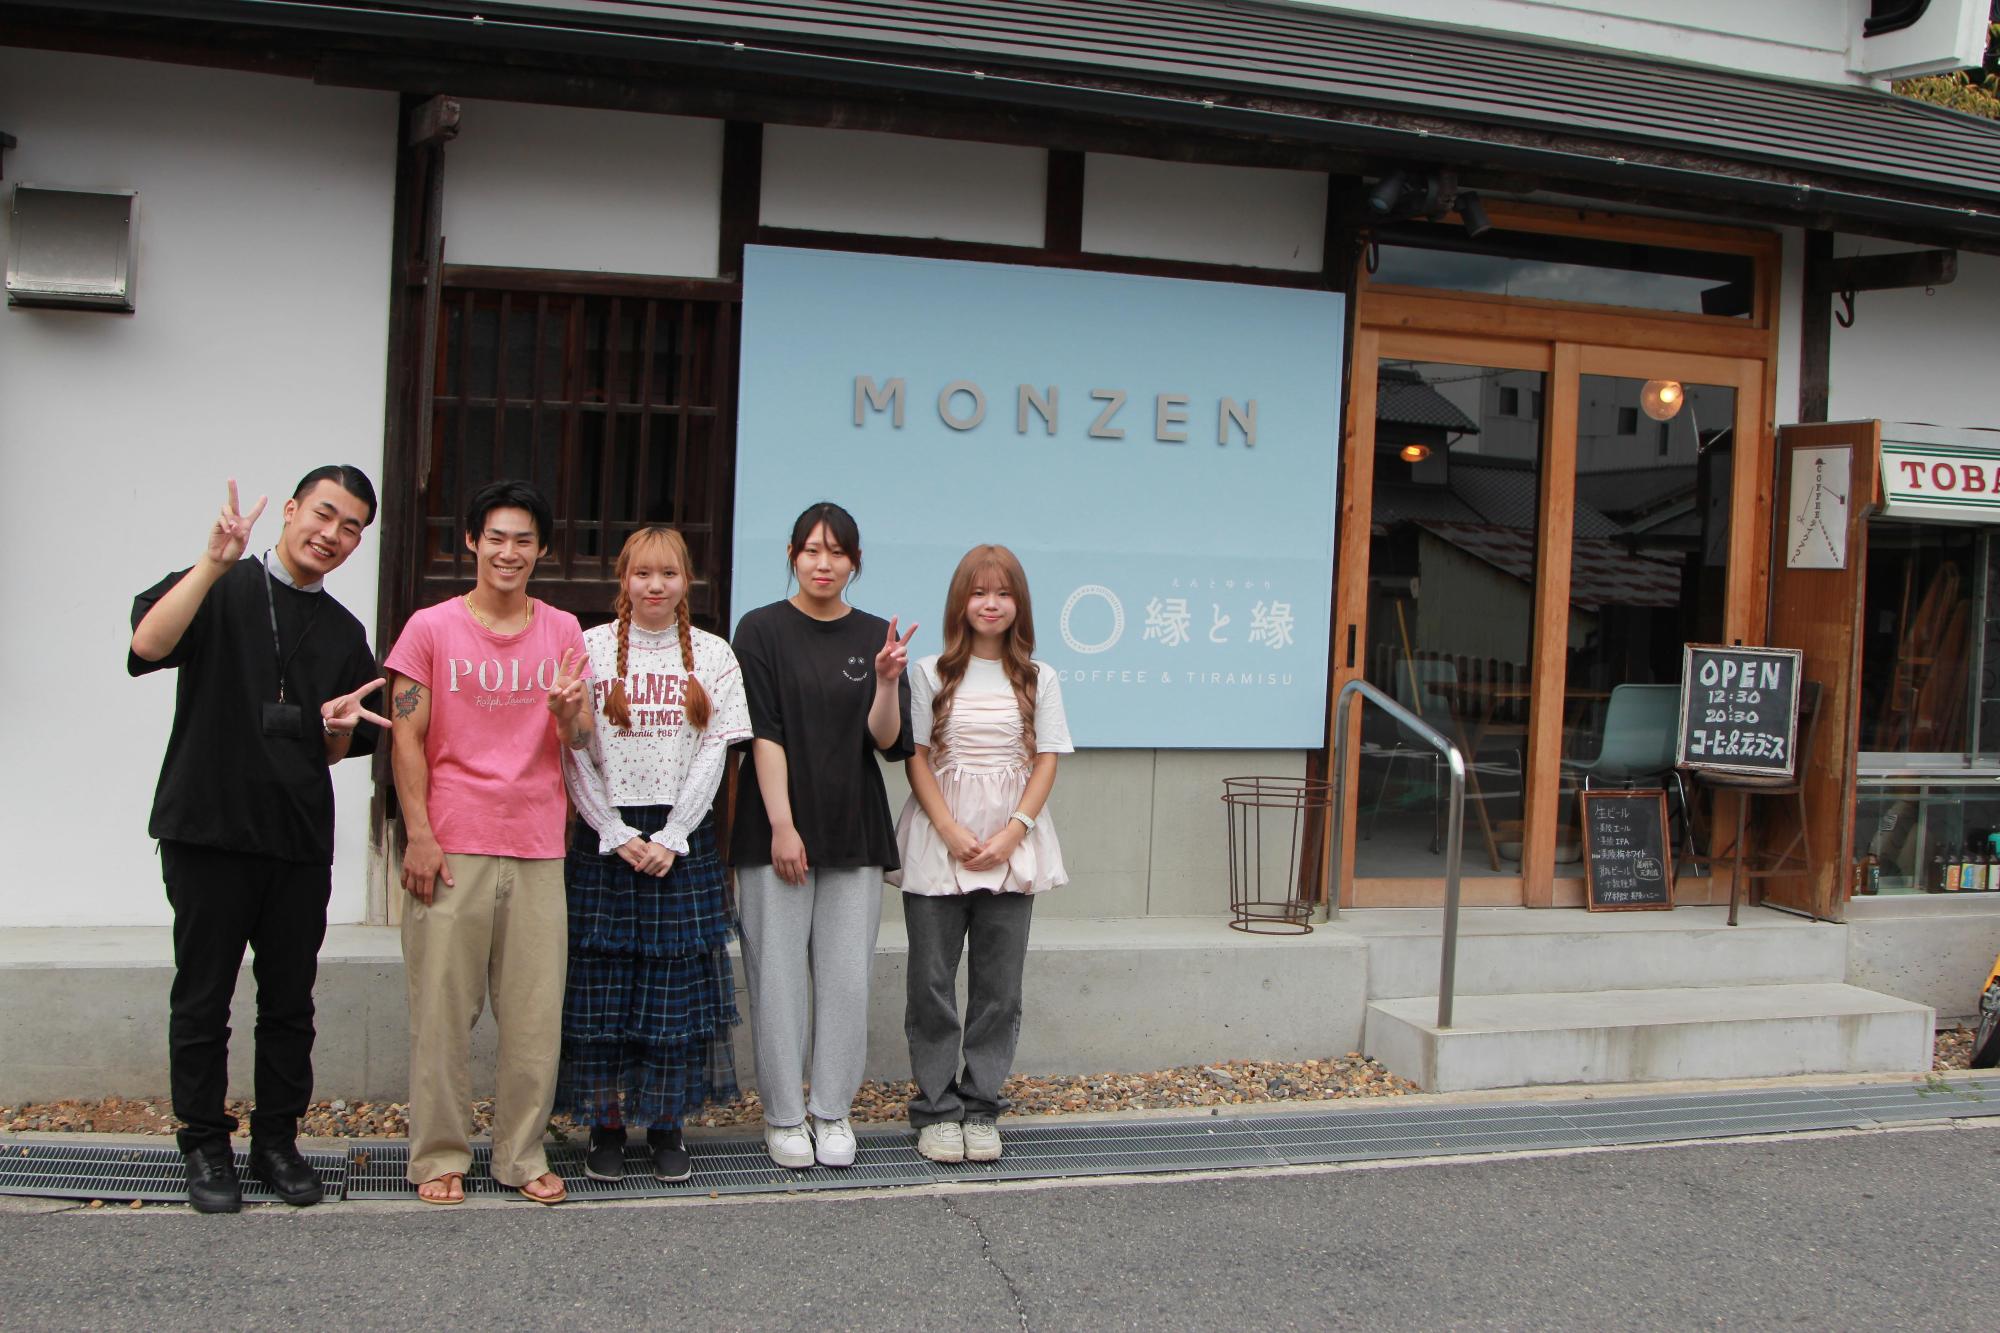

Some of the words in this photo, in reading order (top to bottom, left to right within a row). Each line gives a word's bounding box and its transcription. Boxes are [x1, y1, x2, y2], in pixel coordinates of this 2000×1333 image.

[853, 375, 1257, 447] MONZEN
[448, 657, 560, 692] POLO
[1058, 670, 1147, 683] COFFEE
[1161, 672, 1172, 683] &
[1187, 671, 1293, 686] TIRAMISU
[1700, 659, 1780, 690] OPEN
[1708, 690, 1761, 704] 12:30
[637, 710, 684, 726] TIME
[1705, 709, 1760, 724] 20:30
